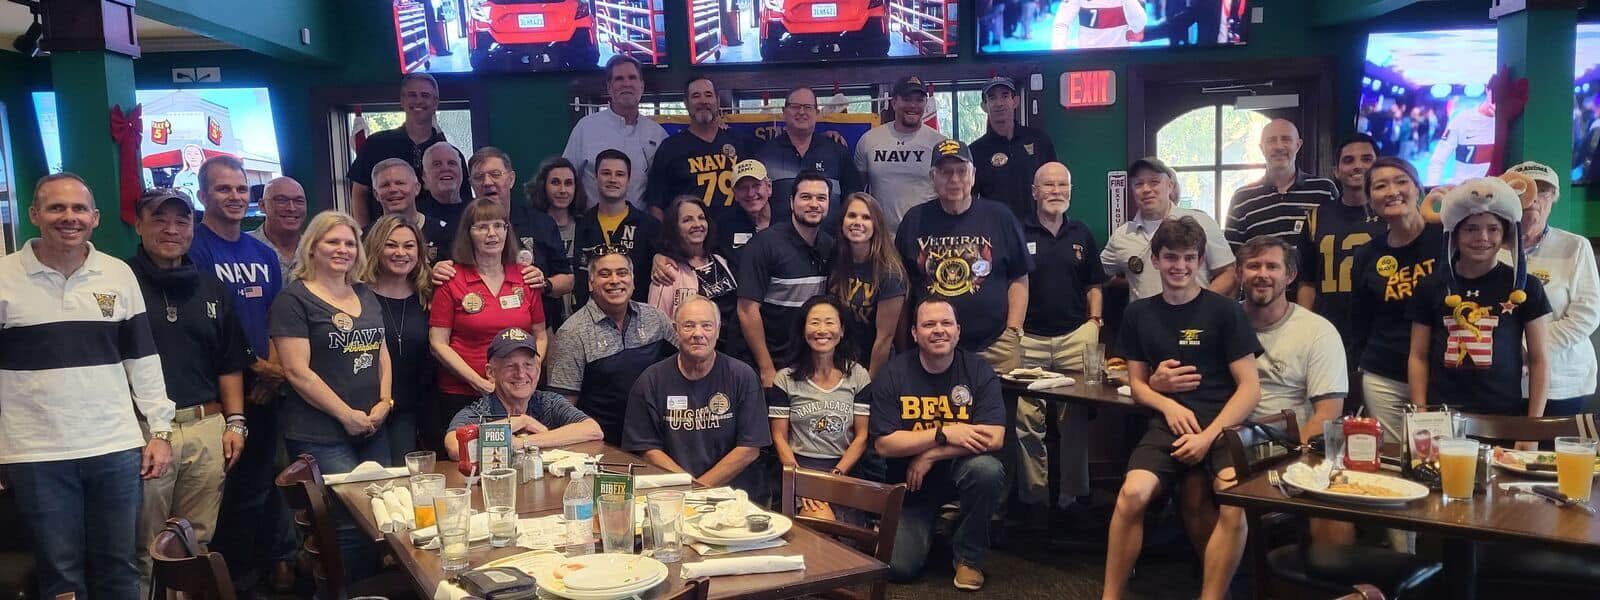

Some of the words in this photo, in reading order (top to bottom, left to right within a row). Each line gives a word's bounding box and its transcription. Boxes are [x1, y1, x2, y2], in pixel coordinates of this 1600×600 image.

[1090, 9, 1098, 27] 7
[1070, 71, 1109, 104] EXIT
[154, 128, 162, 139] 5
[874, 150, 925, 162] NAVY
[1465, 145, 1475, 163] 7
[687, 154, 738, 174] NAVY
[697, 171, 736, 207] 79
[1111, 179, 1125, 188] FIRE
[622, 225, 637, 241] N
[917, 235, 992, 250] VETERAN
[1320, 233, 1373, 293] 12
[1387, 258, 1436, 287] BEAT
[214, 263, 270, 284] NAVY
[900, 395, 969, 420] BEAT
[669, 408, 720, 430] USNA
[485, 431, 505, 441] PROS
